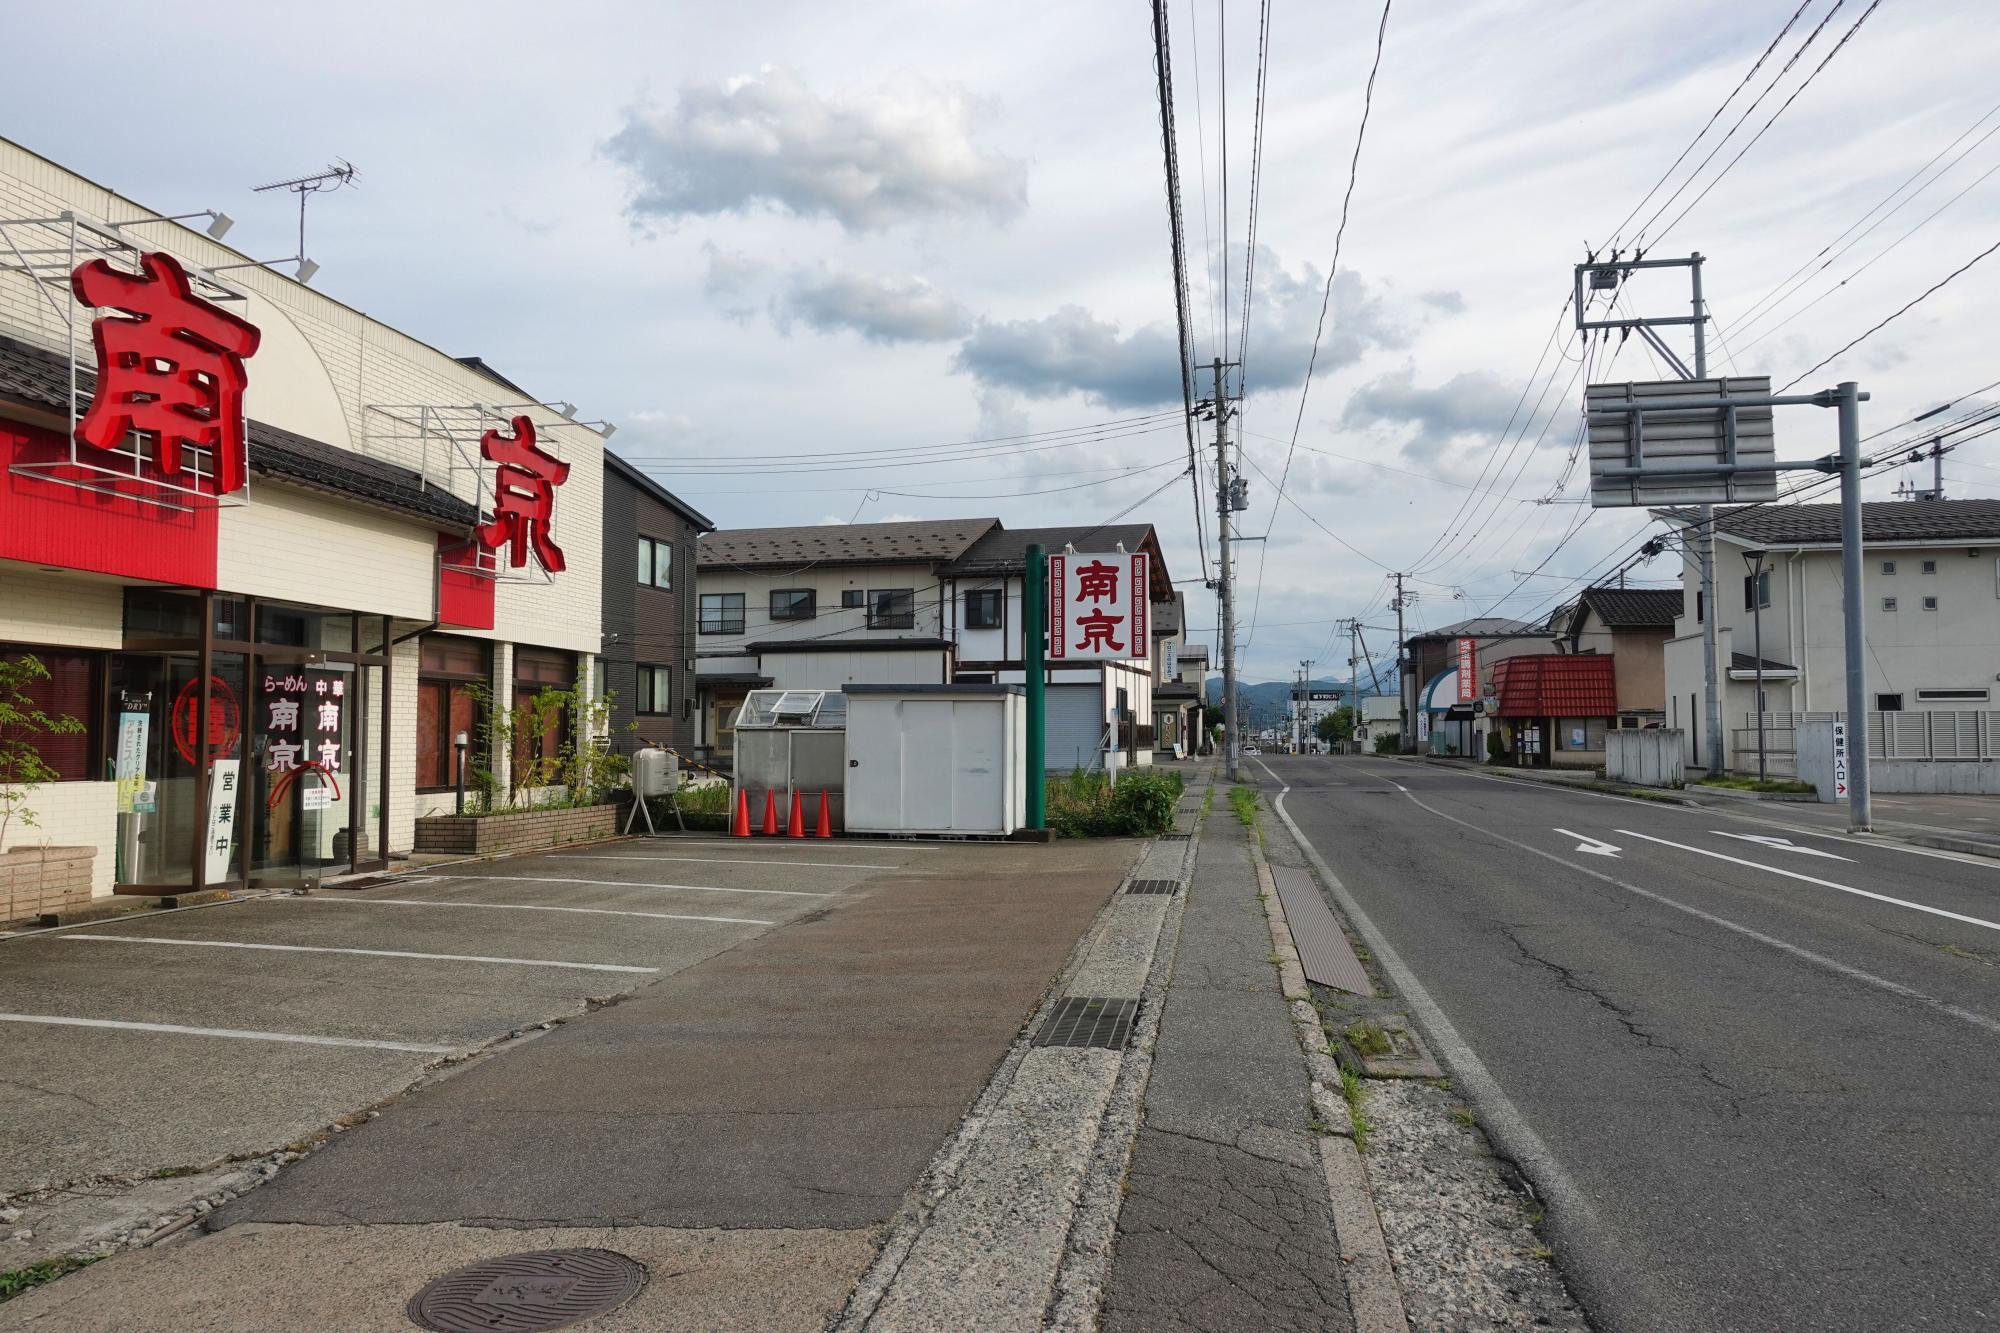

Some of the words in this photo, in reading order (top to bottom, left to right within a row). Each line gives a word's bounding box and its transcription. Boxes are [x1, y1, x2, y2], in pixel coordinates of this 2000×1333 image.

[1075, 560, 1125, 652] 南京
[264, 675, 308, 692] らーめん
[316, 679, 344, 697] 中華
[268, 697, 302, 773] 南京
[317, 700, 341, 772] 南京
[1835, 726, 1845, 779] 保健所入口
[216, 771, 235, 857] 営業中
